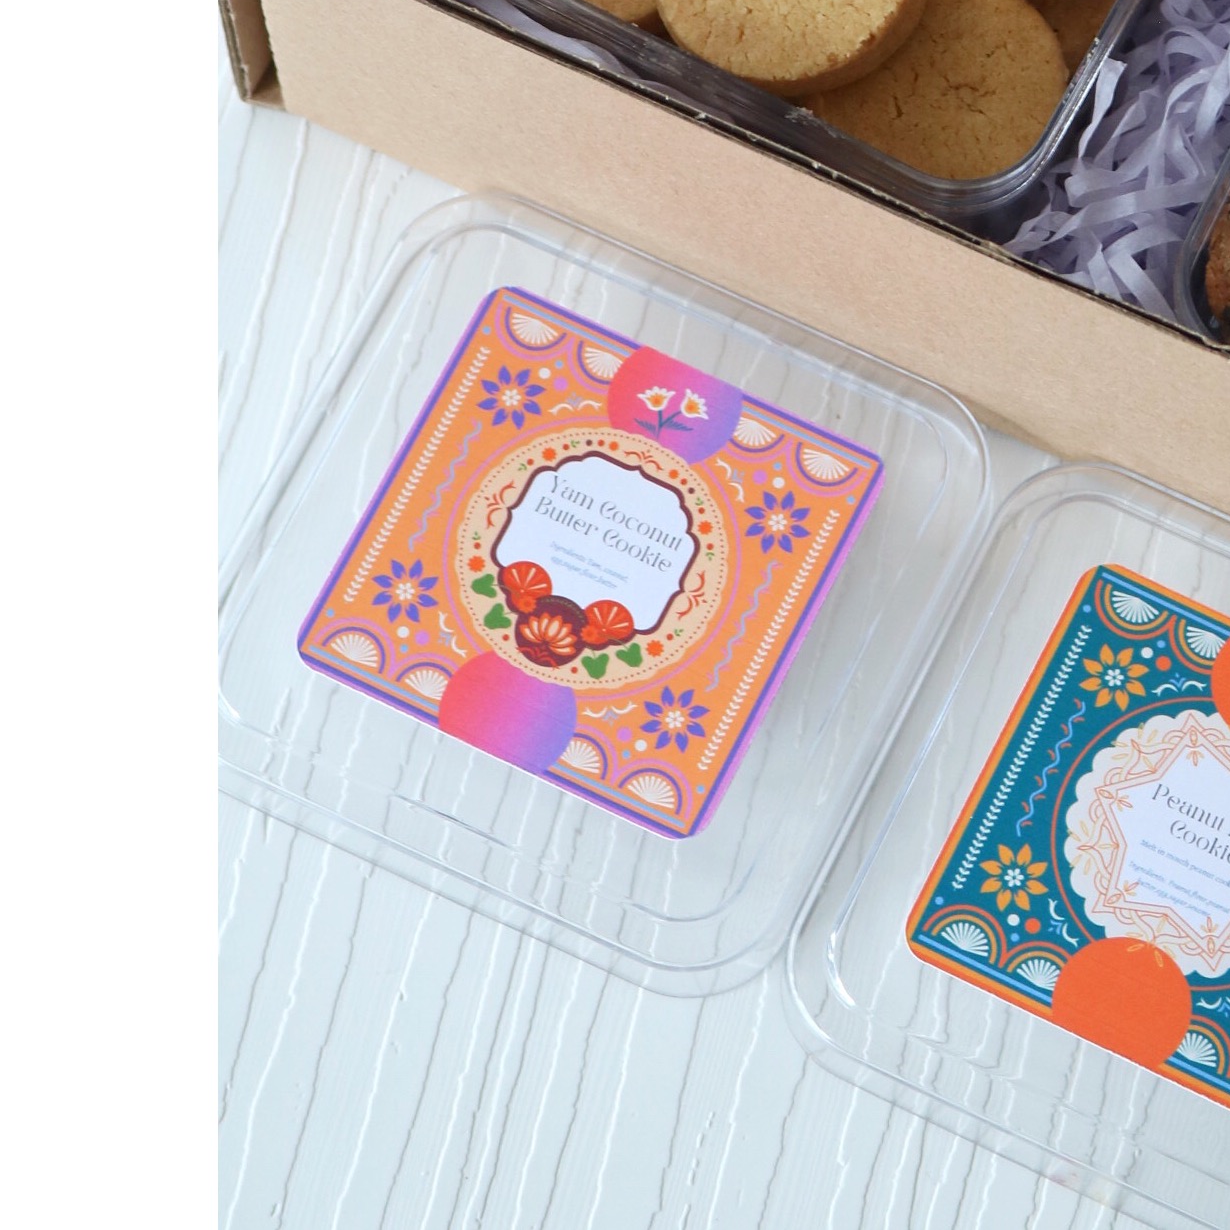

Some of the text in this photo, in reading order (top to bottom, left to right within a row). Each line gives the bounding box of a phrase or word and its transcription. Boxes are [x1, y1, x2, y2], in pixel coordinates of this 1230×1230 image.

[534, 496, 673, 572] Butter Cookie
[550, 475, 683, 552] Yam Coconut
[1152, 783, 1225, 831] Peanut
